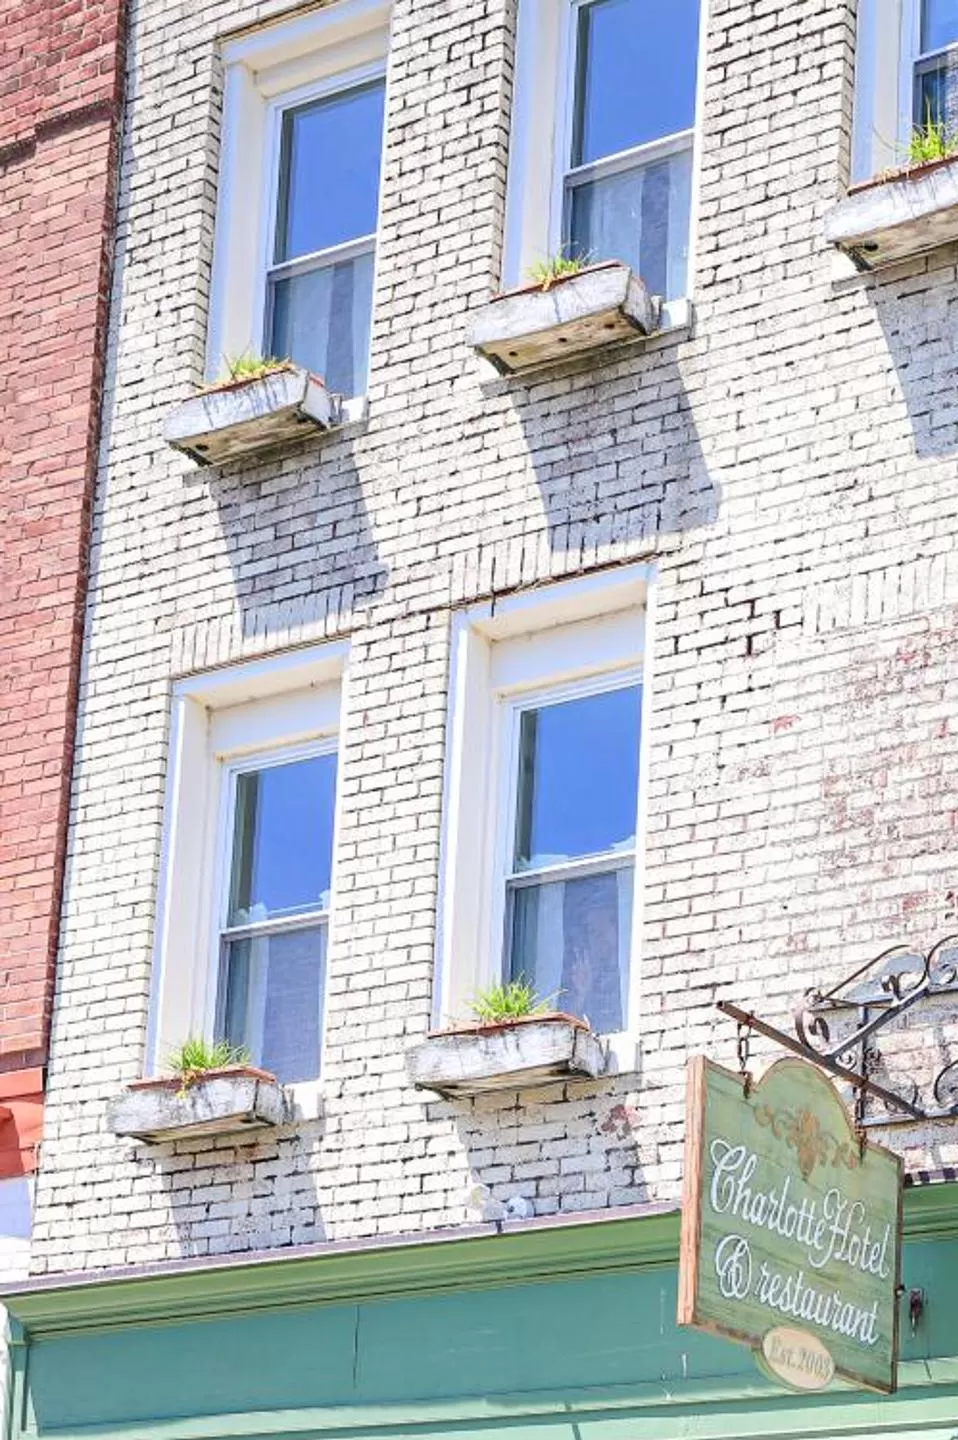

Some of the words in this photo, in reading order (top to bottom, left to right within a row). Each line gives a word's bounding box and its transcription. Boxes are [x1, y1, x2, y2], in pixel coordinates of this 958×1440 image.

[710, 1139, 821, 1249] Charlotte
[809, 1188, 890, 1279] Hotel
[755, 1260, 879, 1346] restaurant
